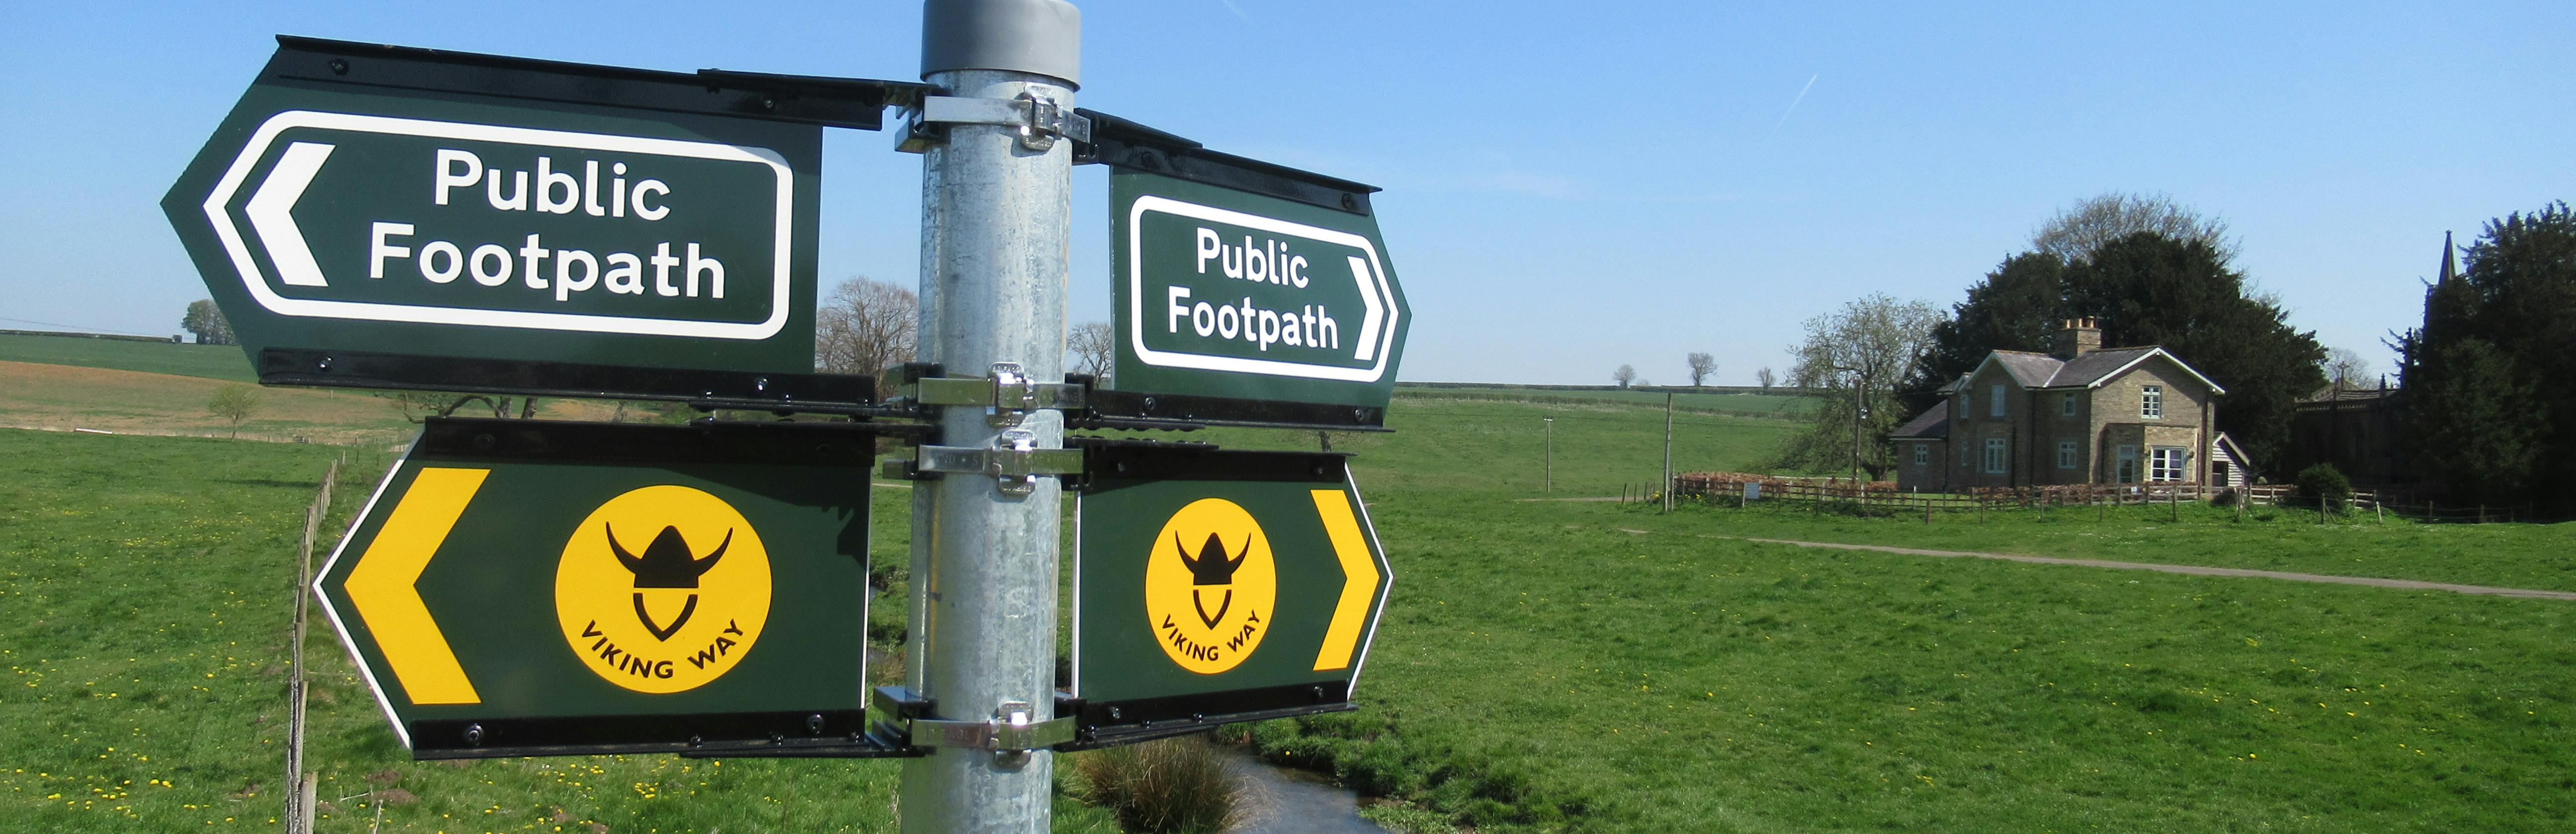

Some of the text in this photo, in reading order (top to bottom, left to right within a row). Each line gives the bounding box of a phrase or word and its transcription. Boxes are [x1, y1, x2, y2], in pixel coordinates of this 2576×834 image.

[435, 149, 670, 221] Public
[370, 222, 724, 301] Footpath
[1197, 227, 1309, 289] Public
[1169, 285, 1338, 351] Footpath
[581, 618, 744, 679] VIKING WAY
[1162, 609, 1260, 662] VIKING WAY
